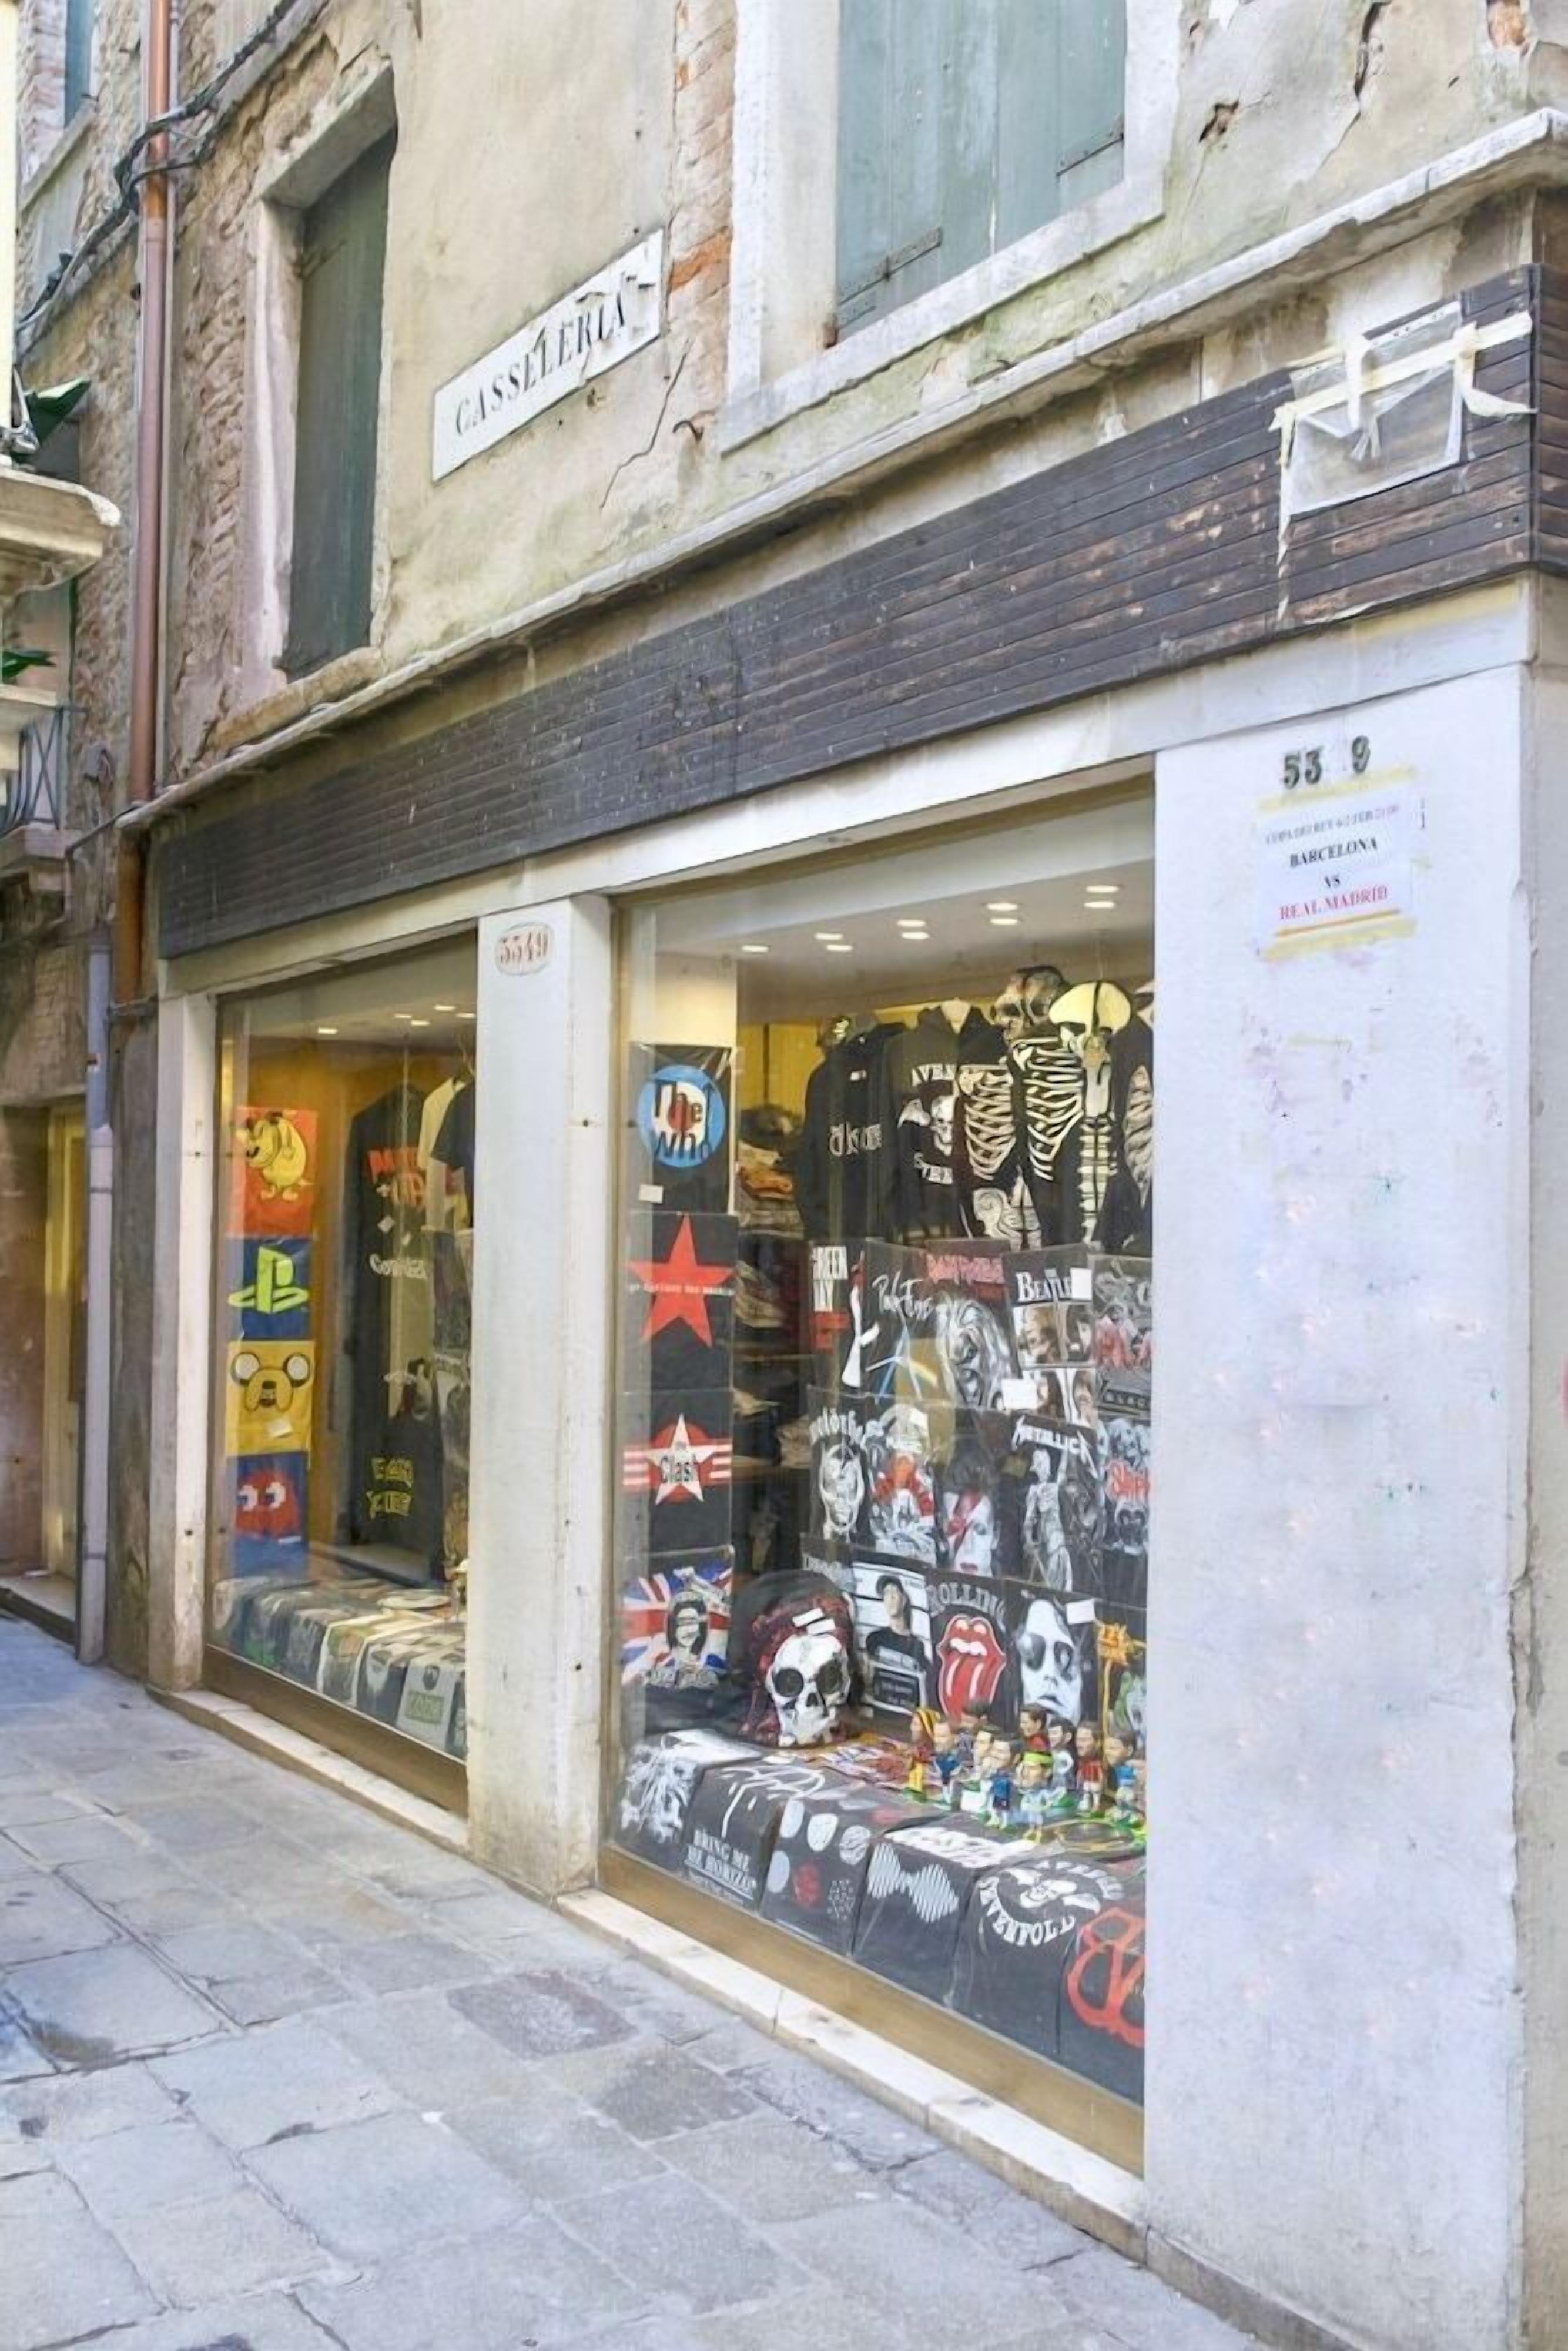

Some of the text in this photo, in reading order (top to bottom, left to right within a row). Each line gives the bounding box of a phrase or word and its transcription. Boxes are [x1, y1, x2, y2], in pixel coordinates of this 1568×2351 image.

[1290, 836, 1378, 867] BARCELONA
[1280, 885, 1388, 920] REAL MADRID
